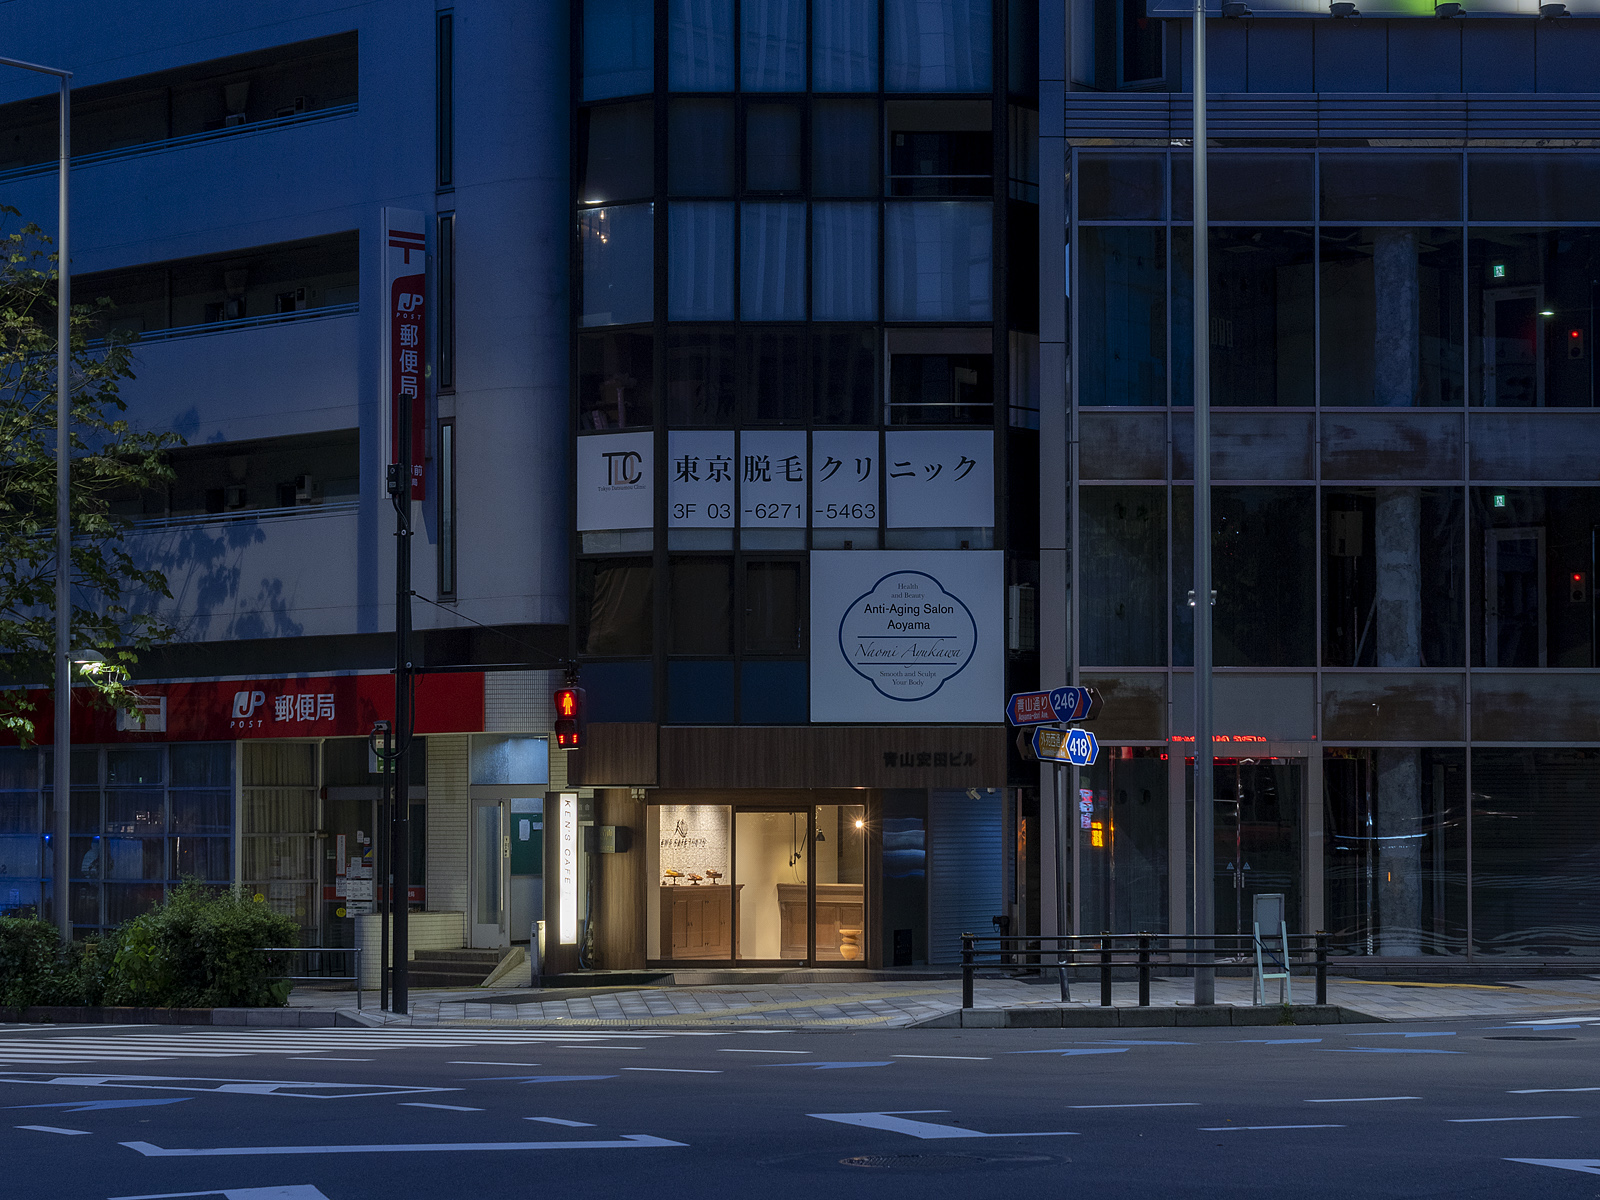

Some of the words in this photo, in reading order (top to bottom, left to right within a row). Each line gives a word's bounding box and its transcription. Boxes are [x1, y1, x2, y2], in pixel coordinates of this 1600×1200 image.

[399, 324, 418, 400] 郵便局
[673, 454, 977, 483] 東京脱毛クリニック
[673, 503, 697, 519] 3F
[864, 604, 920, 616] Anti-Aging
[923, 604, 954, 614] Salon
[887, 620, 930, 632] Aoyama
[855, 642, 899, 657] Naomi
[901, 639, 963, 668] Ayukawa
[908, 679, 924, 687] Body
[275, 693, 335, 722] 郵便局
[1017, 696, 1048, 713] 青山通り
[1054, 692, 1075, 710] 246
[230, 720, 263, 728] POST
[1069, 738, 1087, 757] 418
